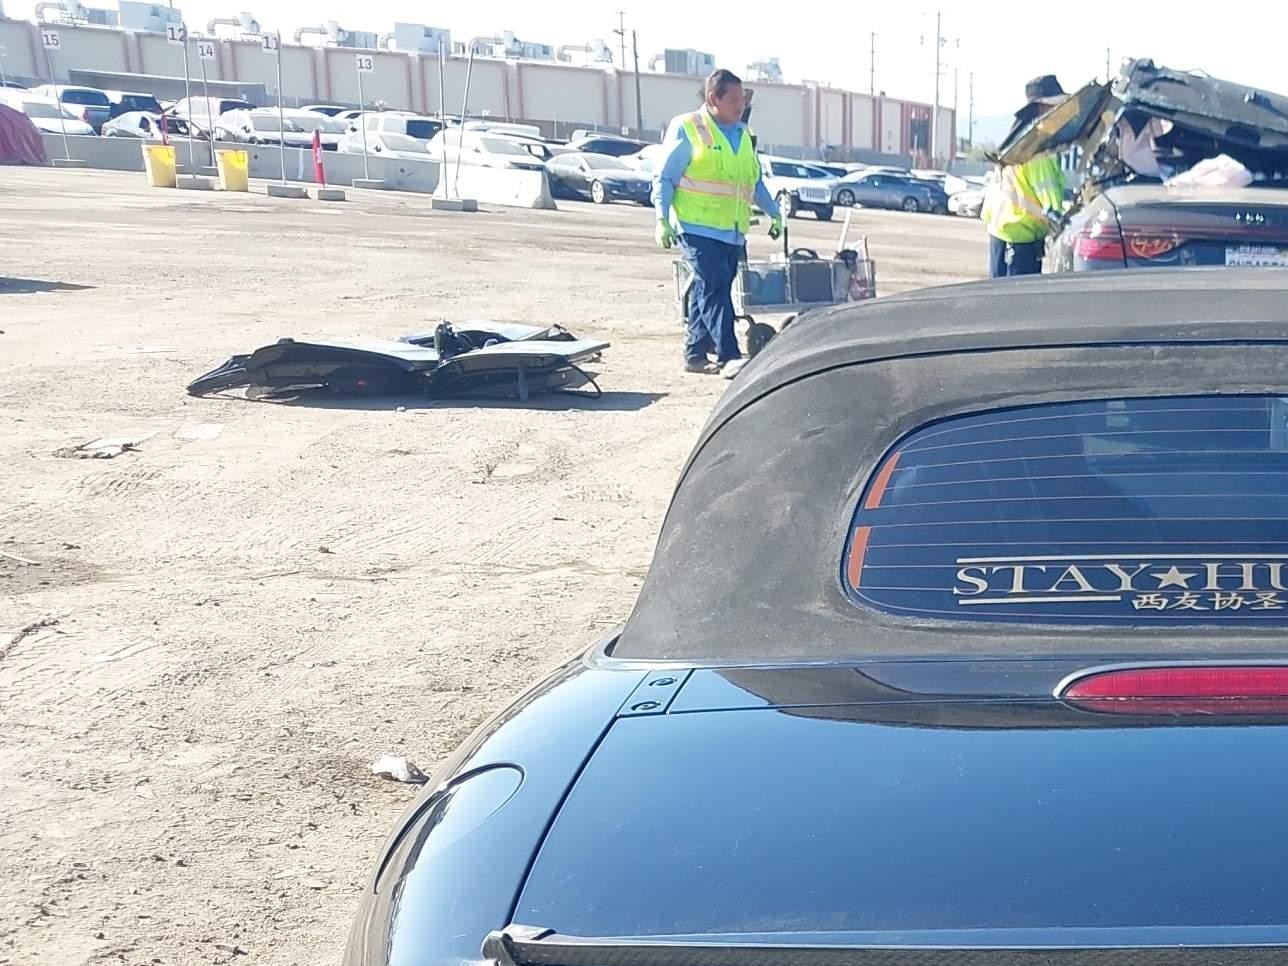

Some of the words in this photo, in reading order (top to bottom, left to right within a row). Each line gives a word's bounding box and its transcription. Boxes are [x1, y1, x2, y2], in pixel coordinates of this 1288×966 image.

[43, 34, 60, 46] 15
[199, 45, 214, 57] 14
[357, 58, 373, 70] 13
[953, 562, 1154, 596] STAY
